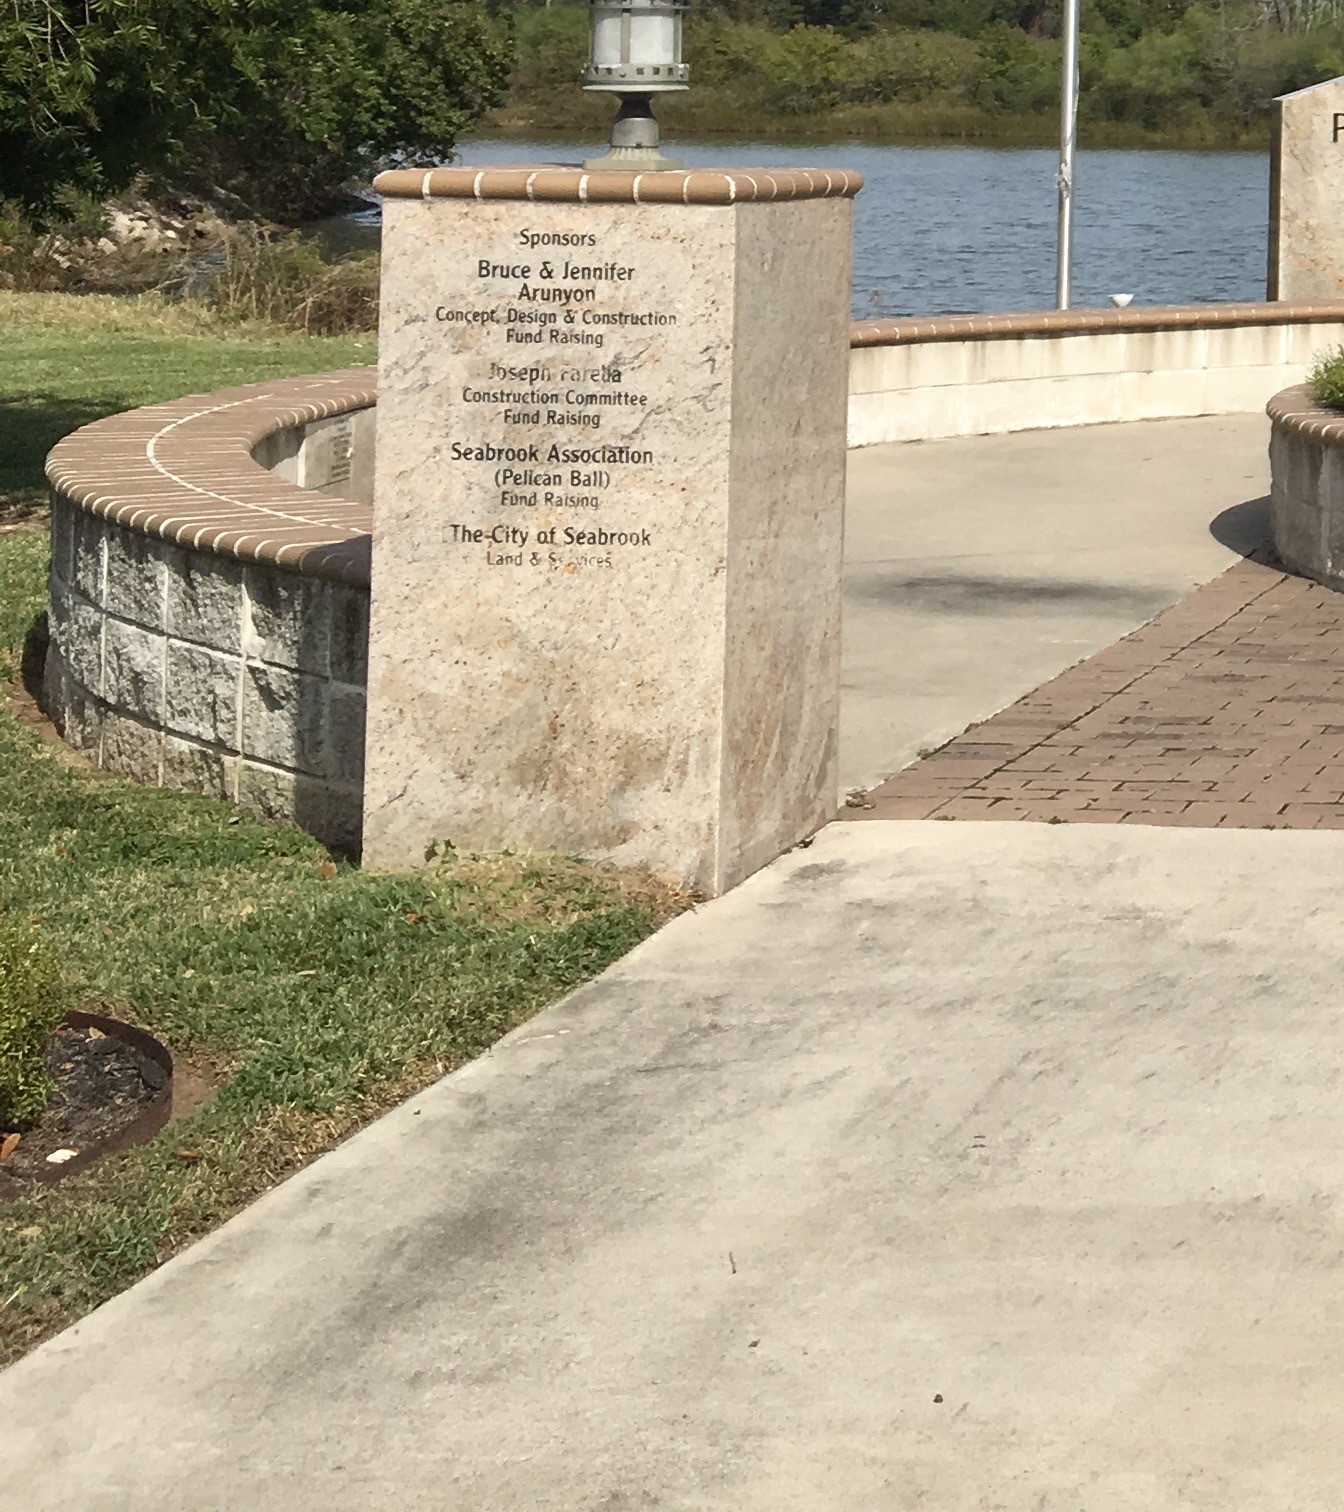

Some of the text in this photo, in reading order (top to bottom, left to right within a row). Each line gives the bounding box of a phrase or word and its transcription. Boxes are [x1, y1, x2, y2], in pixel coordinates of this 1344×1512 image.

[519, 228, 596, 249] Sponsors
[478, 260, 635, 281] Bruce & Jennifer
[517, 283, 596, 306] Arunyon
[507, 308, 557, 327] Design
[563, 310, 576, 324] &
[582, 310, 677, 326] Construction
[506, 329, 604, 348] Fund Raising
[462, 388, 648, 406] Construction Committee
[503, 409, 600, 429] Fund Raising
[451, 442, 653, 464] Seabrook Association
[494, 469, 610, 489] (Pelican Ball)
[501, 491, 599, 510] Fund Raising
[450, 524, 651, 548] The City of Seabrook
[486, 551, 523, 566] Land
[529, 552, 541, 565] &
